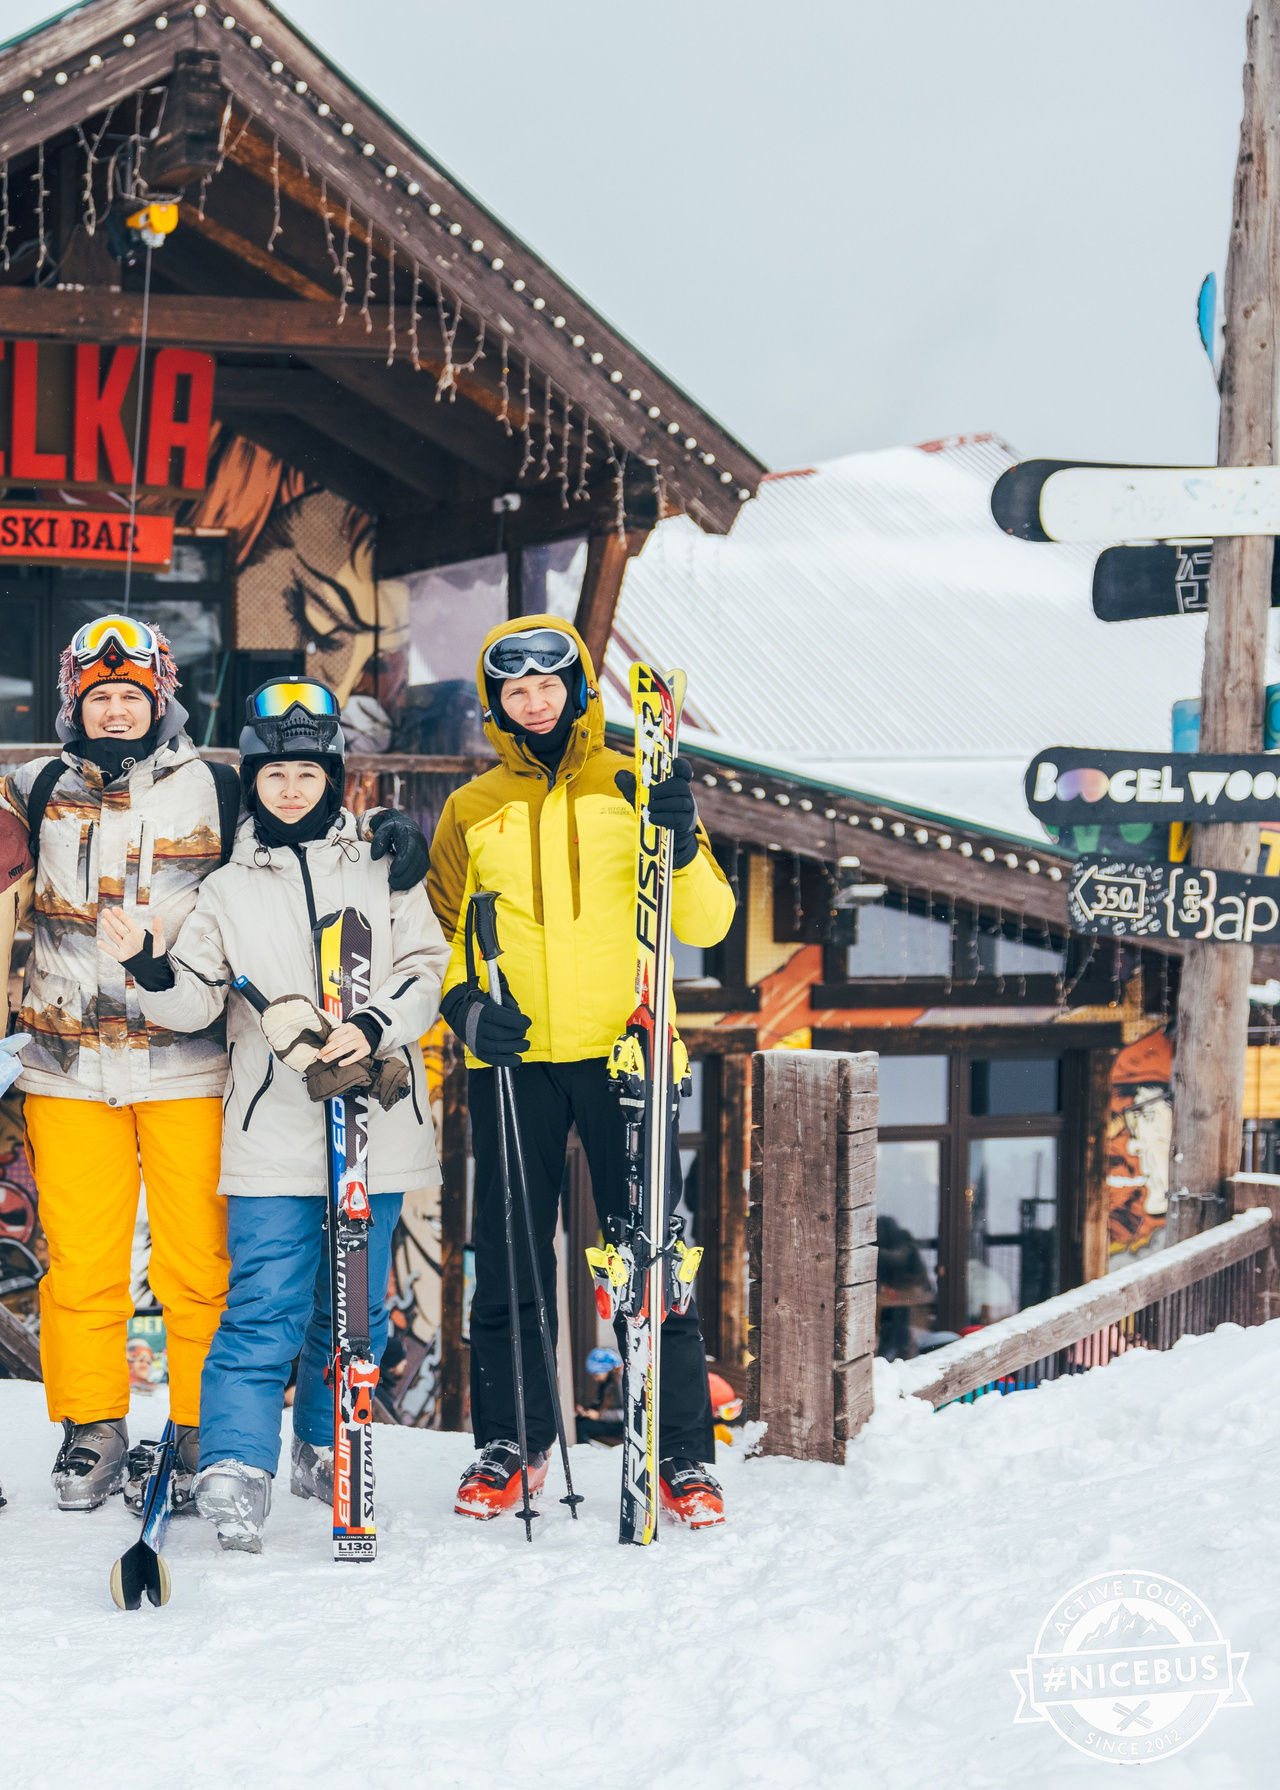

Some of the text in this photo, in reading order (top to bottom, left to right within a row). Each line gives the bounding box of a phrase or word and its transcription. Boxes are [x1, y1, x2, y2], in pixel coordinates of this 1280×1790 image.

[0, 516, 58, 548] SKI
[71, 518, 141, 553] BAR
[1188, 770, 1280, 805] WOO
[636, 701, 663, 953] FISCER
[1090, 884, 1134, 911] 350
[336, 1238, 348, 1340] ALOMON
[646, 1367, 655, 1457] WORLDCUP
[363, 1423, 376, 1522] SALOMO
[338, 1542, 373, 1551] L130
